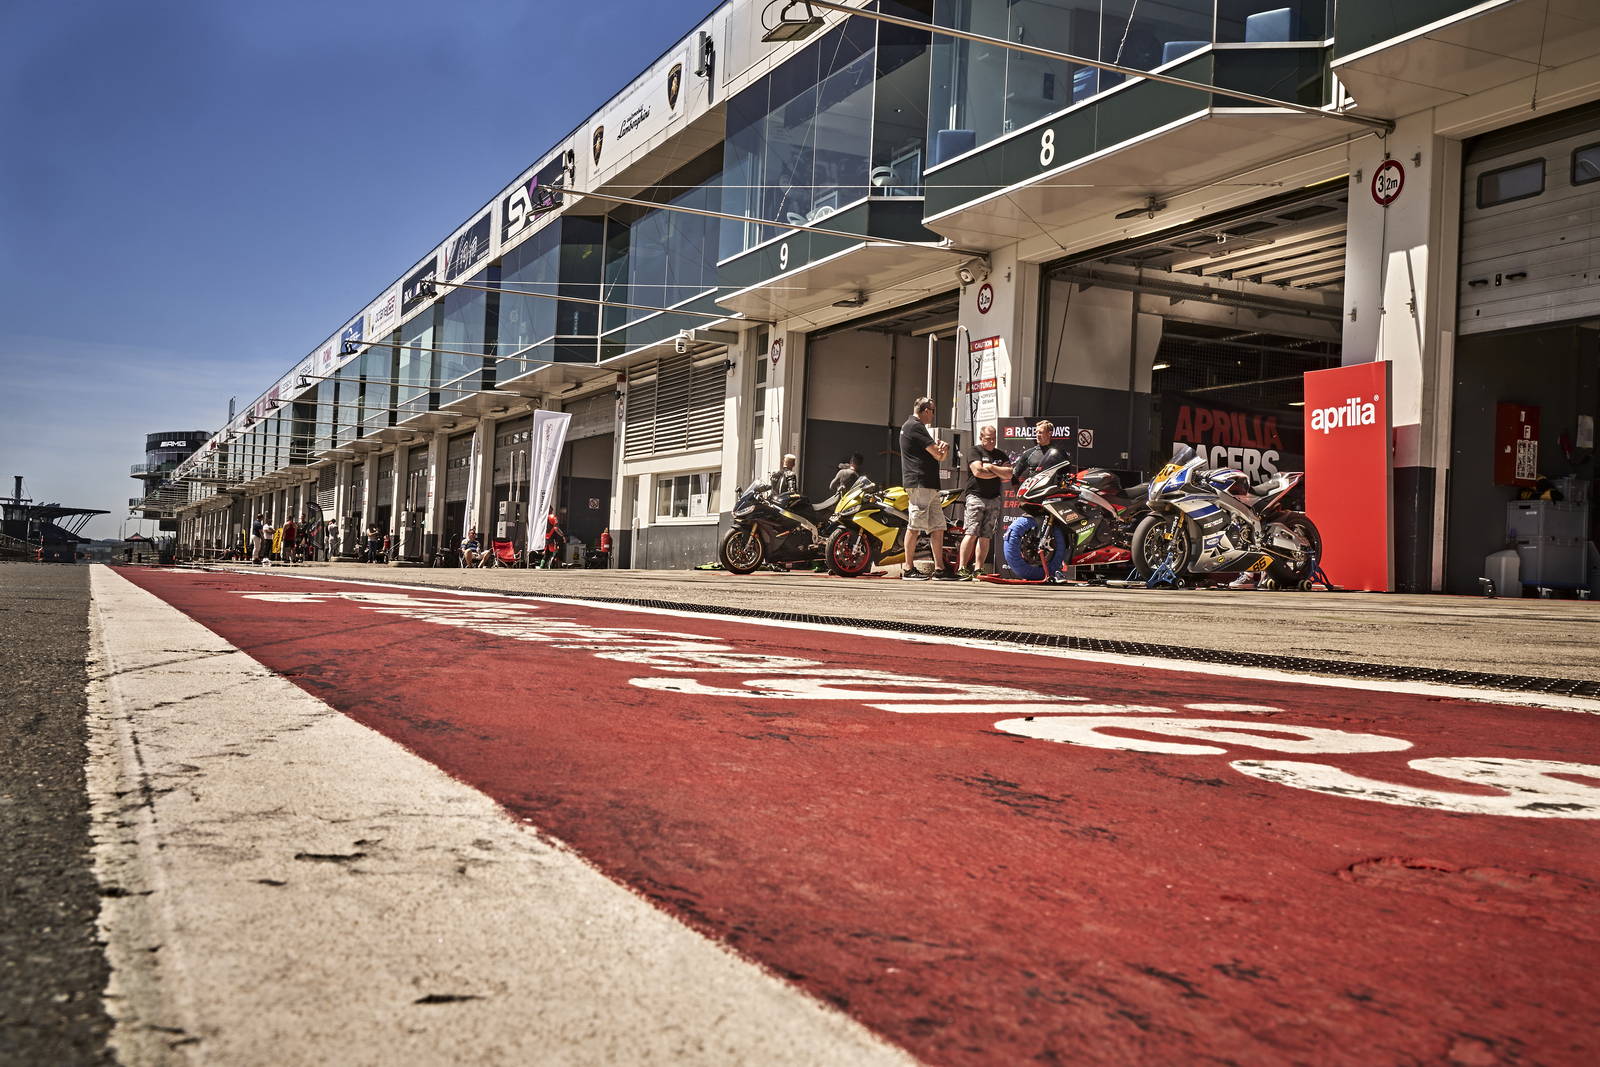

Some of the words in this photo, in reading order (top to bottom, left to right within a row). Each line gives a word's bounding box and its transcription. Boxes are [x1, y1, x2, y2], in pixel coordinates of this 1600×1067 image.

[1040, 129, 1055, 166] 8
[779, 242, 789, 270] 9
[519, 354, 527, 373] 10
[1015, 426, 1037, 437] RACE
[1174, 405, 1283, 450] APRILIA
[1311, 397, 1376, 434] aprilia
